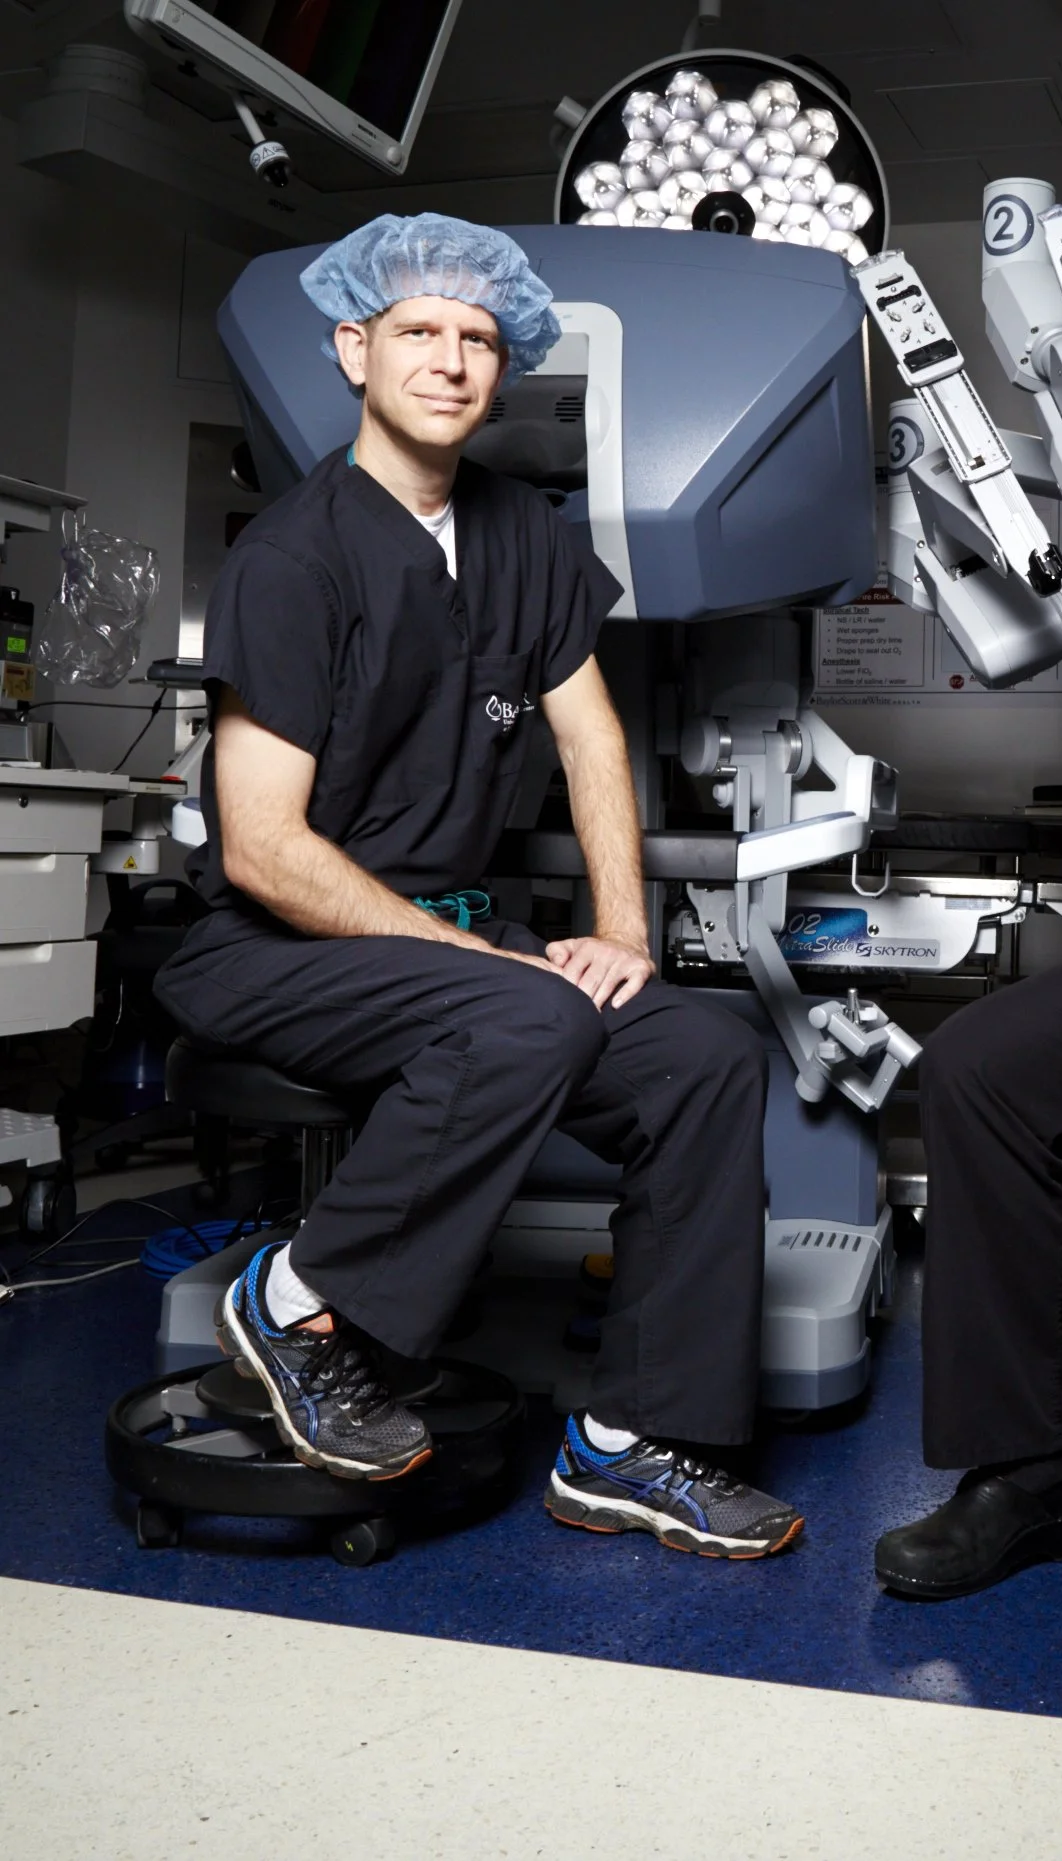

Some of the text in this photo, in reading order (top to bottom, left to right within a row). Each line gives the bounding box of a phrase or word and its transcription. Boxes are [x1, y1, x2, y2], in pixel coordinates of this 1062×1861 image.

[992, 206, 1014, 242] 2
[889, 428, 906, 462] 3
[853, 607, 870, 615] Tech
[836, 637, 858, 645] Proper
[836, 647, 857, 655] Drape
[821, 658, 861, 666] Anesthesia
[872, 945, 938, 957] SKYTRON
